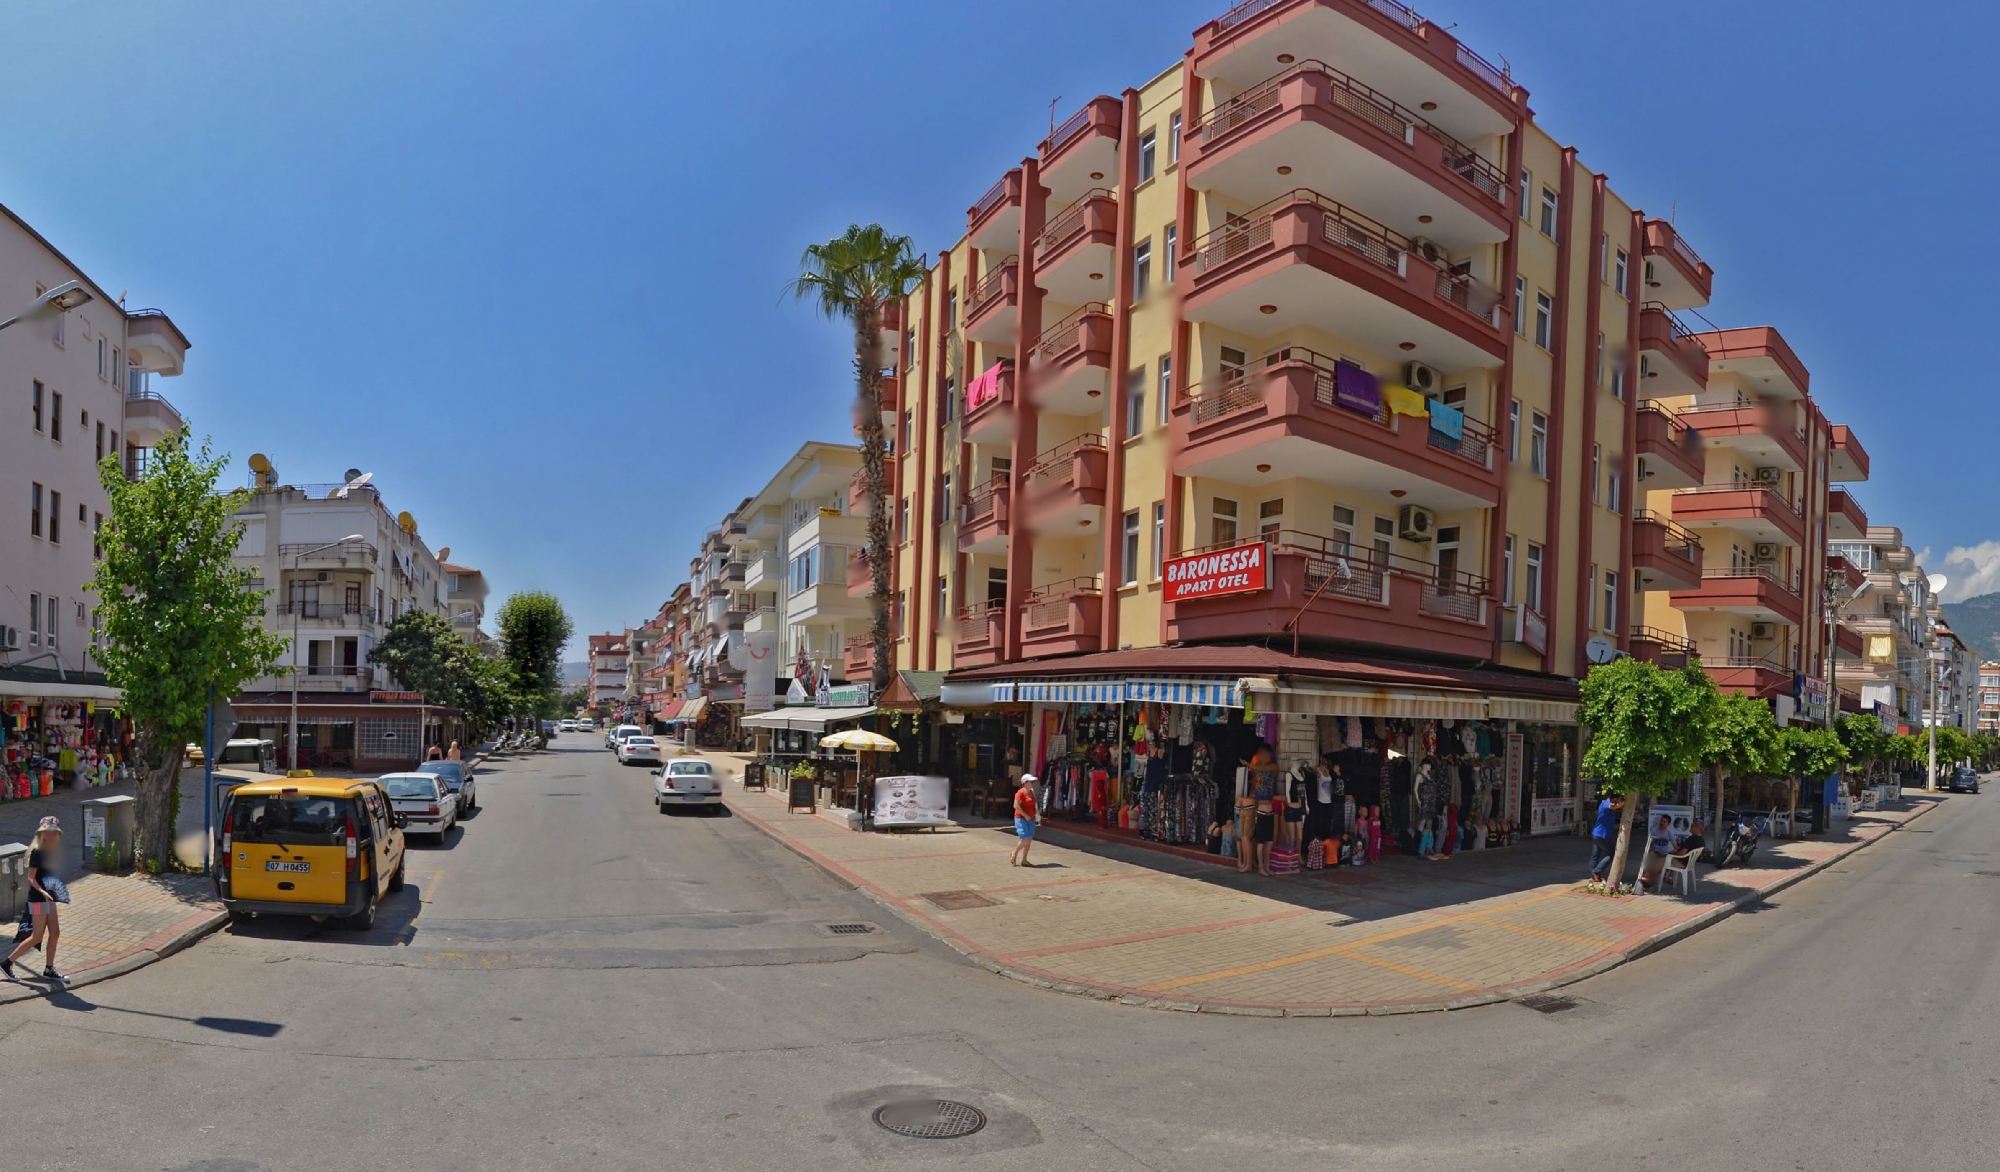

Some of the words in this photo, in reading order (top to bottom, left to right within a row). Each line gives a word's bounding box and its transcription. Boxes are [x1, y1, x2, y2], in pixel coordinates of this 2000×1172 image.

[1167, 548, 1260, 583] BARONESSA
[1176, 578, 1216, 596] APART
[1217, 573, 1249, 589] OTEL
[270, 862, 280, 870] 07
